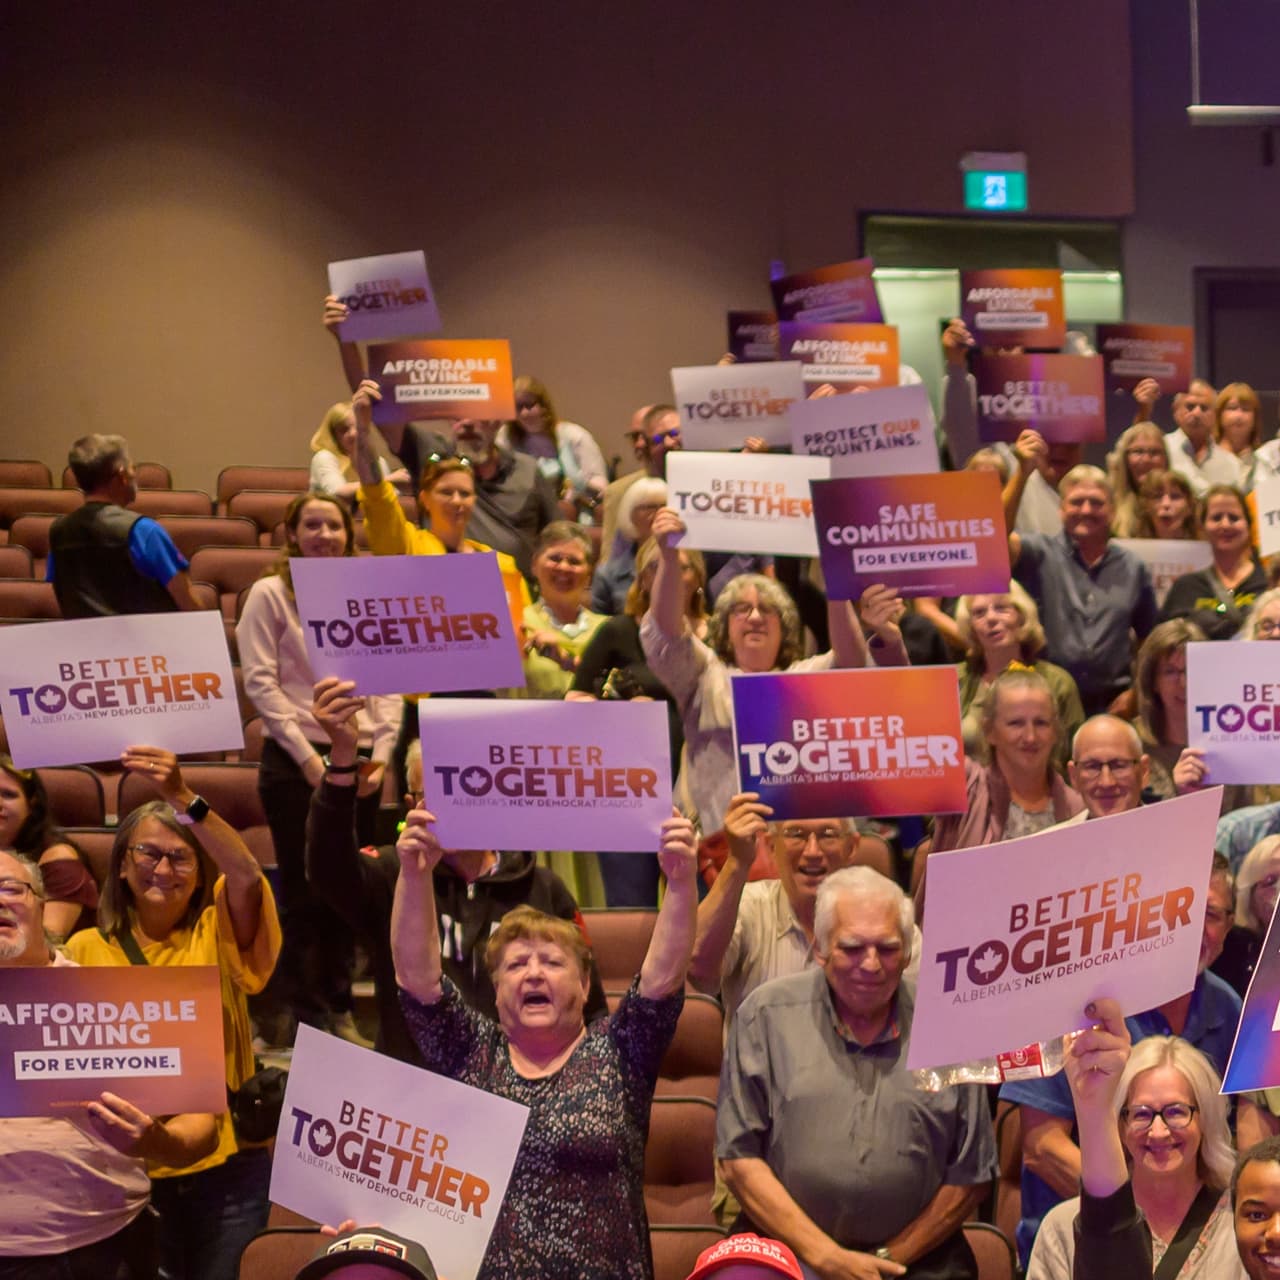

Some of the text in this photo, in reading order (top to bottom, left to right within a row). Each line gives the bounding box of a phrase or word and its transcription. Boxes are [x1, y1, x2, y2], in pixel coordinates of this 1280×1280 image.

[790, 339, 888, 353] AFFORDABLE
[814, 351, 865, 364] LIVING
[382, 358, 496, 374] AFFORDABLE
[410, 371, 471, 384] LIVING
[803, 418, 921, 445] PROTECT OUR
[711, 479, 786, 494] BETTER
[878, 503, 937, 523] SAFE
[826, 518, 996, 547] COMMUNITIES
[858, 548, 973, 566] FOR EVERYONE.
[346, 595, 447, 618] BETTER
[308, 611, 501, 650] TOGETHER
[58, 654, 169, 683] BETTER
[9, 670, 223, 717] TOGETHER
[30, 711, 83, 727] ALBERTA'S
[86, 708, 108, 720] NEW
[110, 704, 168, 718] DEMOCRAT
[793, 715, 905, 742] BETTER
[1258, 734, 1280, 742] NEW
[489, 744, 602, 766] BETTER
[741, 734, 959, 775] TOGETHER
[434, 765, 658, 799] TOGETHER
[759, 773, 813, 786] ALBERTA'S
[815, 771, 840, 783] NEW
[842, 769, 902, 782] DEMOCRAT
[509, 797, 597, 809] NEW DEMOCRAT
[1009, 872, 1143, 934] BETTER
[935, 886, 1195, 994] TOGETHER
[952, 934, 1176, 1006] ALBERTA'S NEW DEMOCRAT CAUCUS
[0, 1000, 197, 1026] AFFORDABLE
[42, 1023, 151, 1048] LIVING
[20, 1054, 176, 1073] FOR EVERYONE.
[340, 1100, 450, 1161] BETTER
[290, 1107, 490, 1218] TOGETHER
[296, 1150, 466, 1225] ALBERTA'S NEW DEMOCRAT CAUCUS
[707, 1244, 789, 1267] NOT FOR SALE
[719, 1237, 769, 1251] CANADA
